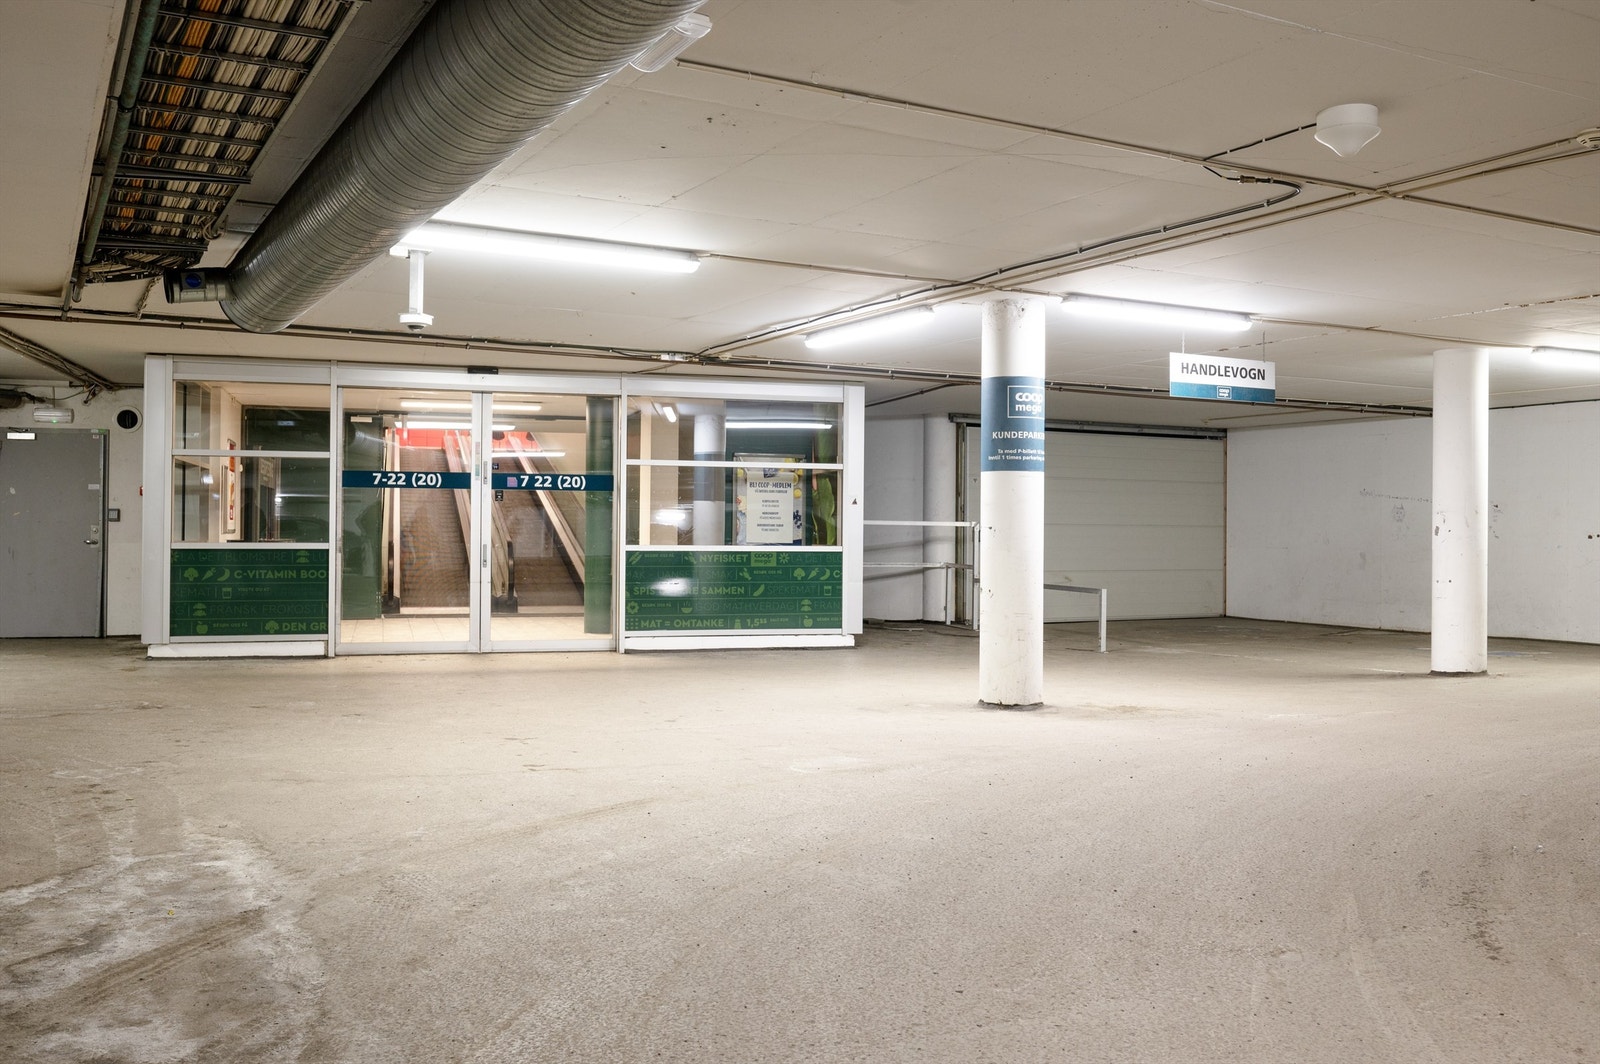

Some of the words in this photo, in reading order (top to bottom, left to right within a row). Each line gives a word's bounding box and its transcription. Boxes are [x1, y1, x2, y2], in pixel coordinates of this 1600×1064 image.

[1181, 362, 1266, 381] HANDLEVOGN
[372, 473, 406, 486] 7-22
[411, 473, 442, 488] (20)
[520, 475, 529, 487] 7
[534, 475, 552, 488] 22
[557, 476, 586, 490] (20)
[700, 554, 748, 563] NYFISKET
[234, 569, 297, 579] C-VITAMIN
[633, 587, 655, 595] SPIS
[702, 586, 745, 595] SAMMEN
[282, 622, 307, 631] DEN
[641, 619, 662, 628] MAT
[674, 619, 724, 628] OMTANKE
